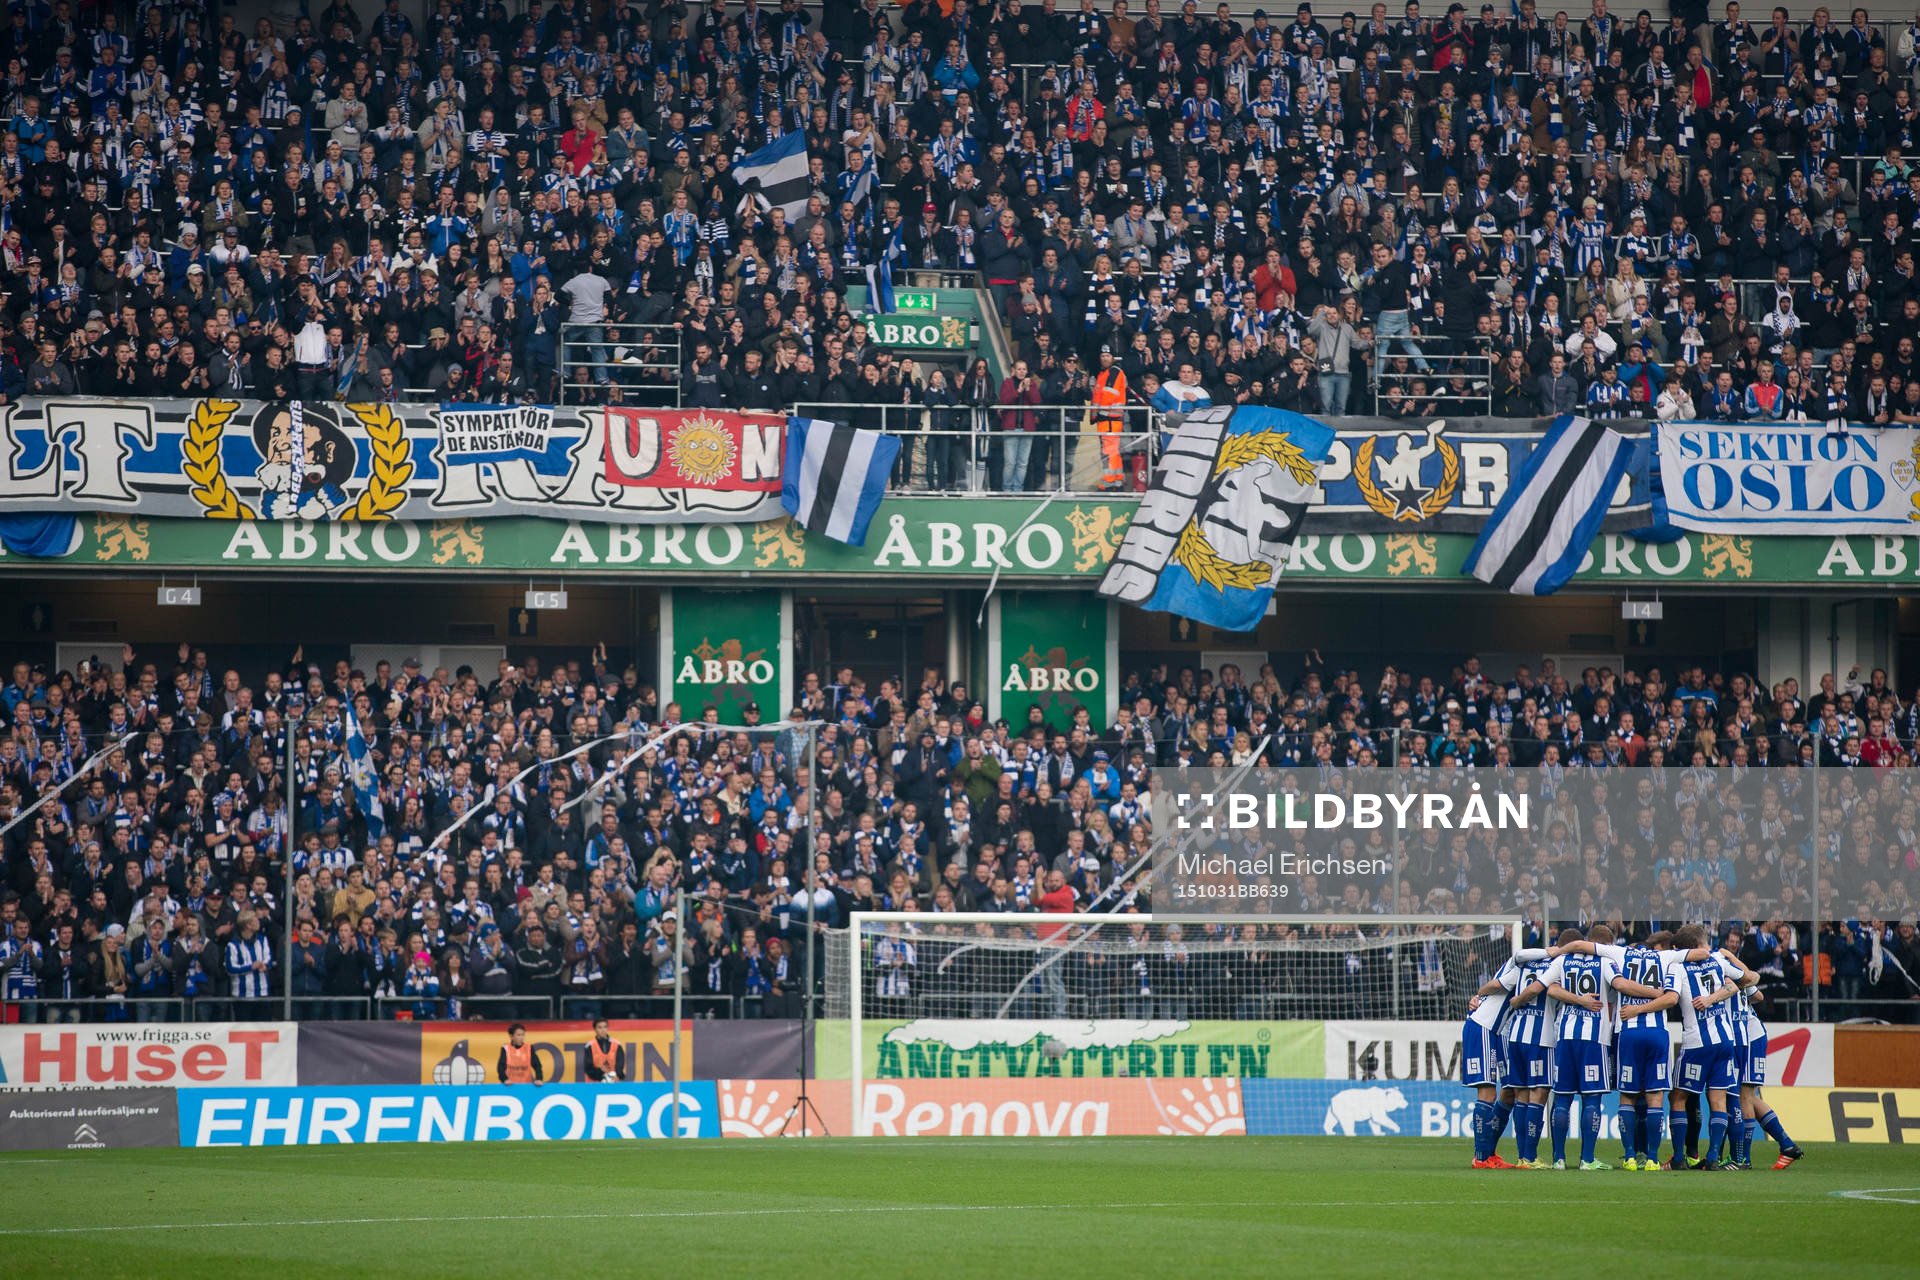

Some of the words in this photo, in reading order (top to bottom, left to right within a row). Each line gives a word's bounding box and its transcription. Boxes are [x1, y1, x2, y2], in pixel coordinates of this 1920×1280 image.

[867, 320, 940, 345] ÅBRO
[443, 413, 517, 433] SYMPATI
[447, 436, 466, 452] DE
[1680, 430, 1879, 463] SEKTION
[1683, 463, 1886, 513] OSLO
[874, 514, 1064, 569] ÅBRO
[1285, 533, 1377, 572] RO
[676, 655, 775, 685] ÅBRO
[1002, 663, 1100, 693] ÅBRO
[1628, 963, 1662, 989] 14
[1700, 974, 1716, 996] 7
[97, 1030, 213, 1045] www.frigga.se
[23, 1030, 280, 1083] HuseT
[9, 1107, 75, 1119] Auktoriserad
[78, 1105, 145, 1119] återförsäljare
[147, 1107, 160, 1115] av
[196, 1091, 702, 1147] EHRENBORG
[861, 1083, 1110, 1136] Renova
[1592, 1111, 1601, 1133] SKF
[1528, 1120, 1537, 1138] SKF
